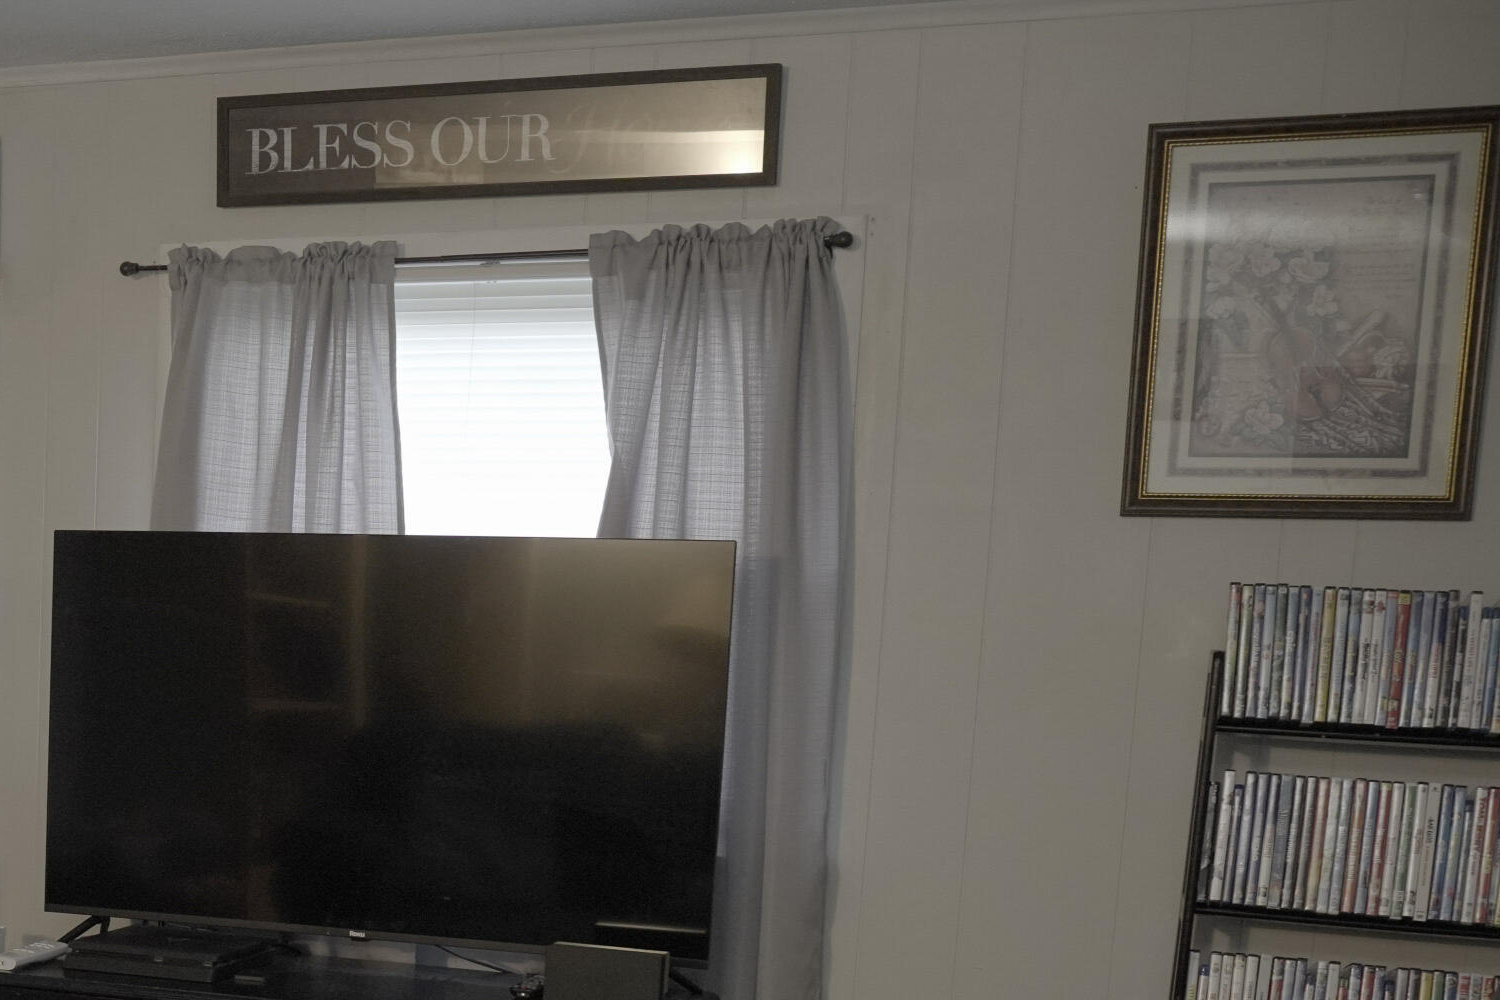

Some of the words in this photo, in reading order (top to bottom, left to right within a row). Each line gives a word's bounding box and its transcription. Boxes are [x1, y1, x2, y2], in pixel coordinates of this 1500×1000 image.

[245, 119, 414, 178] BLESS
[430, 112, 556, 167] OUR
[1285, 630, 1296, 653] epic
